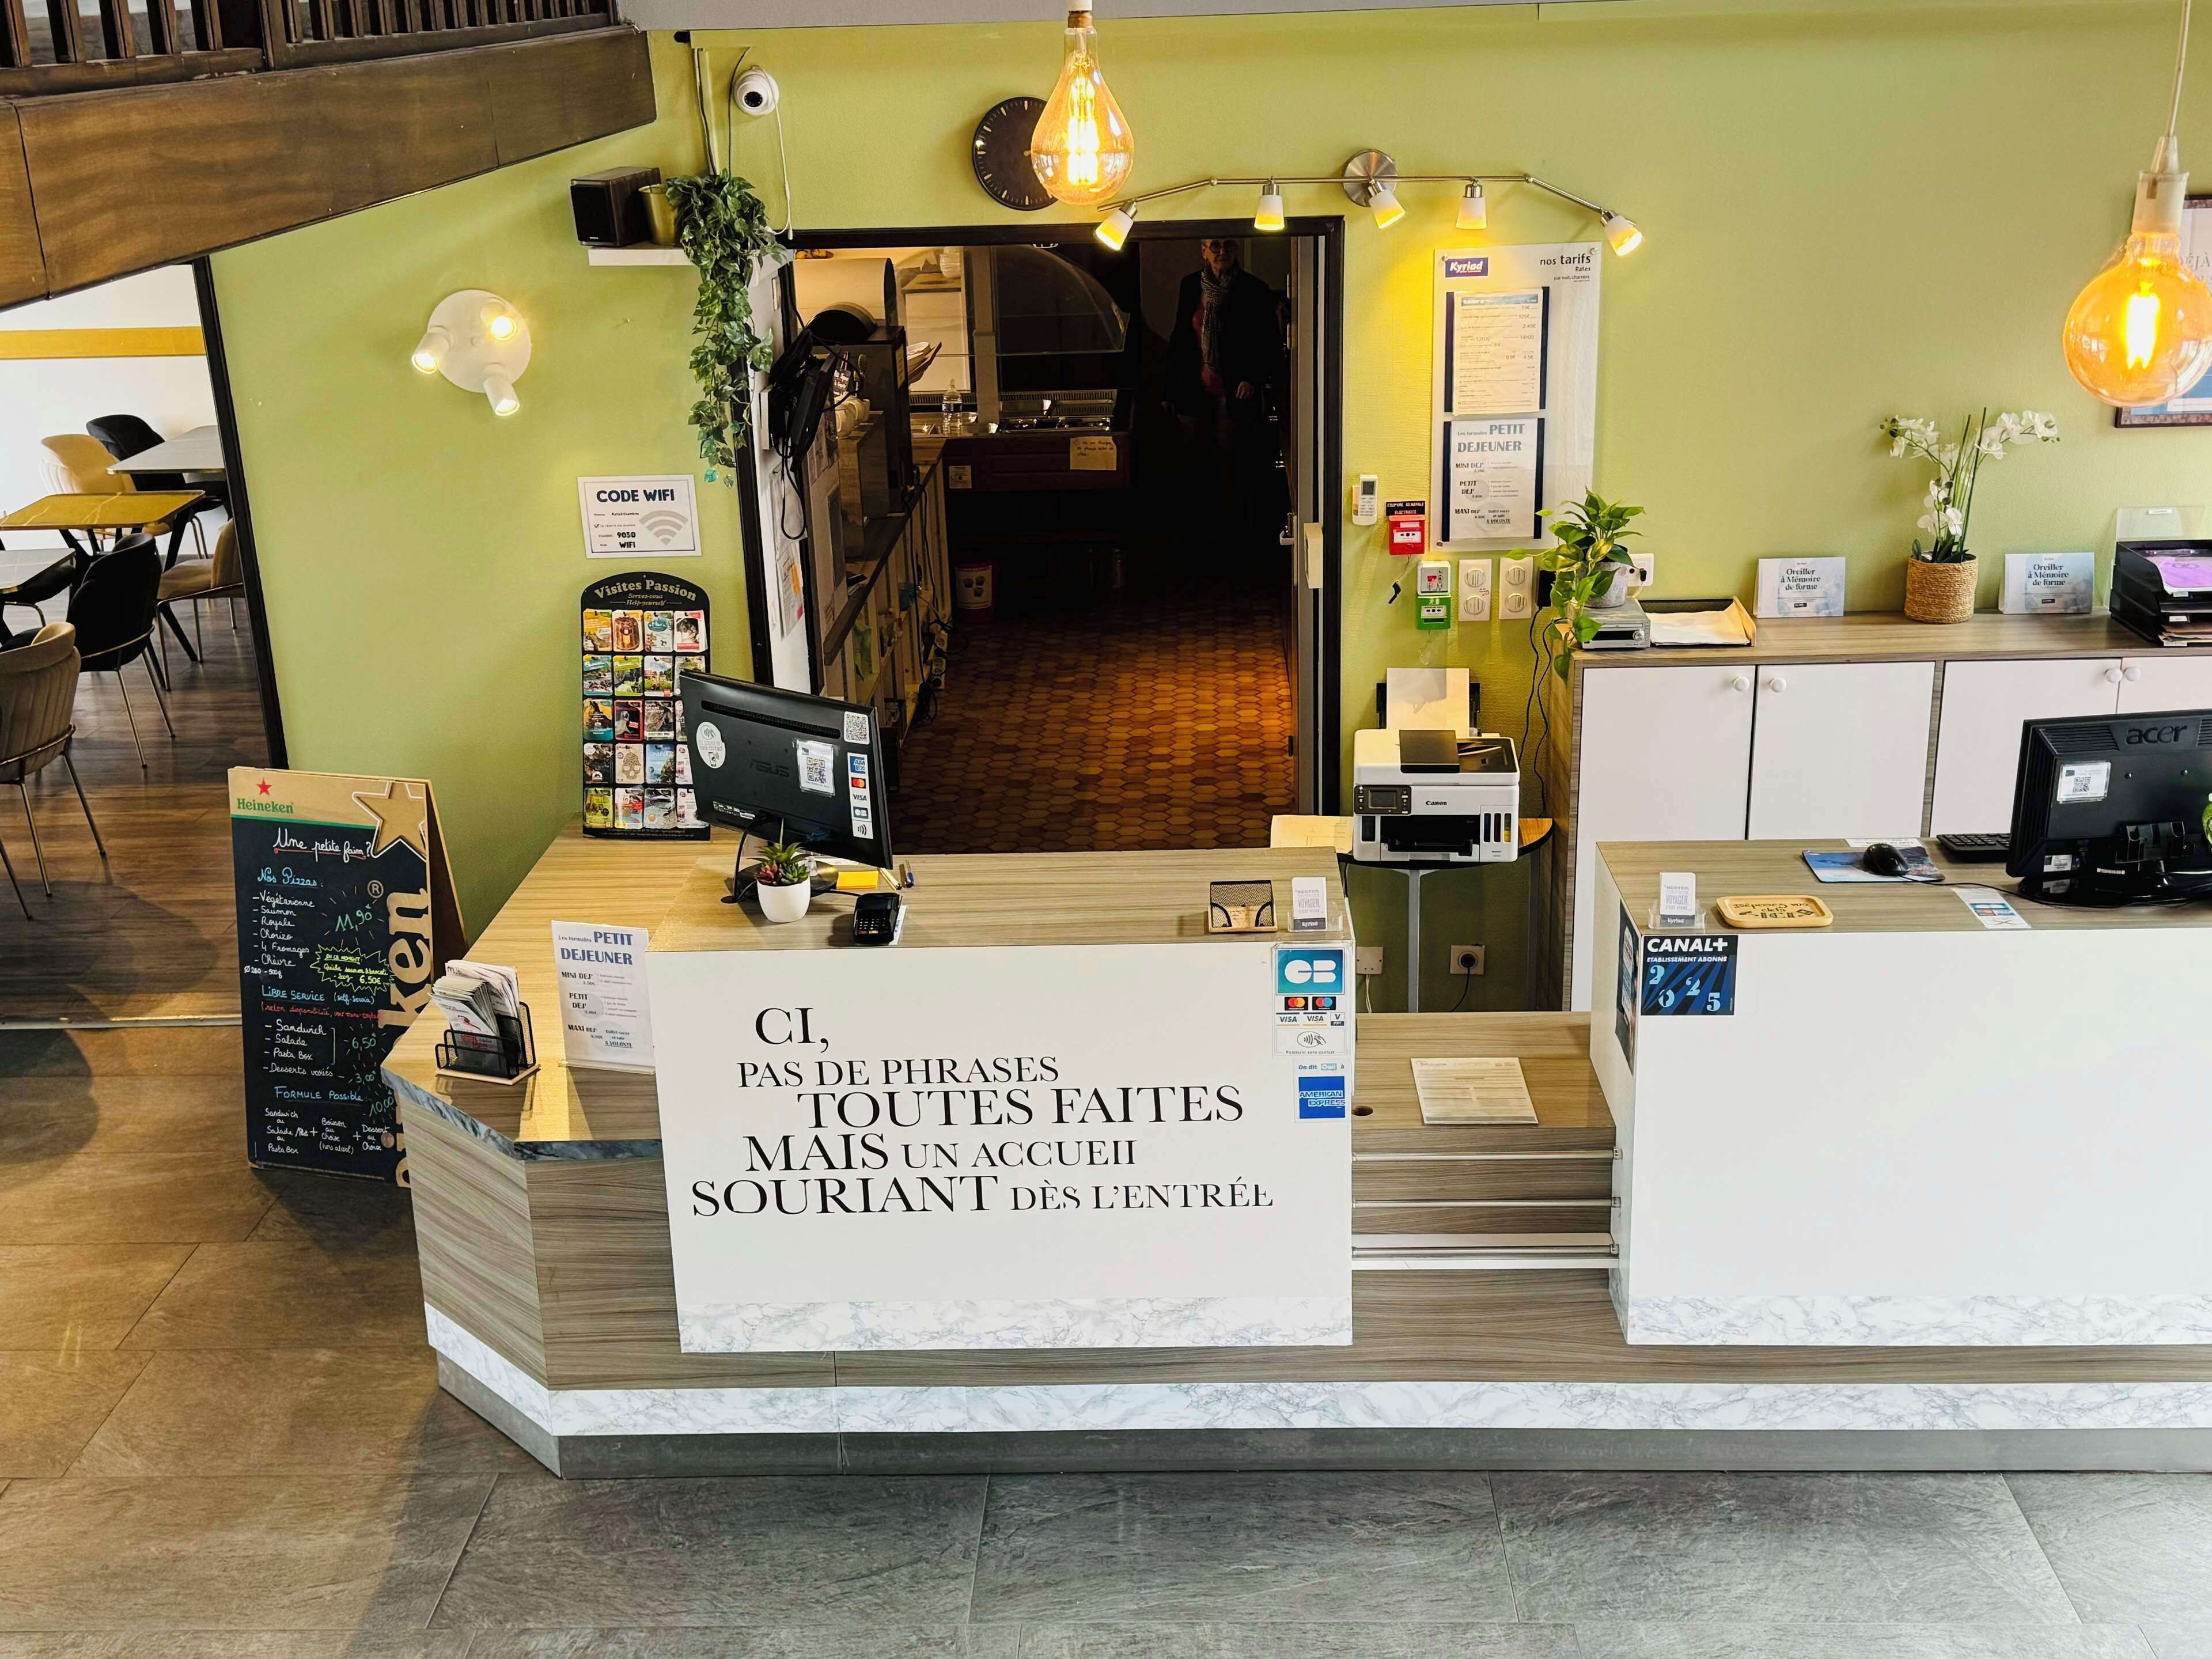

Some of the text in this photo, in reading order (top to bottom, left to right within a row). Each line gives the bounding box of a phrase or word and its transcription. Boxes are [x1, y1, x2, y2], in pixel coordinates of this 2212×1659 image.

[1560, 253, 1591, 264] tarifs
[1450, 260, 1483, 273] Kyriad
[1490, 424, 1525, 435] PETIT
[1457, 441, 1521, 452] DEJEUNER
[596, 489, 675, 502] CODE WIFI
[594, 579, 697, 601] Visites Passion
[2126, 724, 2188, 745] acer
[237, 798, 294, 814] Heineken
[273, 827, 307, 850] Une
[312, 839, 342, 862] petite
[257, 868, 277, 883] Nos
[259, 891, 315, 908] Végétarienne
[260, 906, 297, 917] Saumon
[261, 916, 295, 929] Royale
[260, 927, 293, 941] Chorizo
[593, 931, 634, 946] PETIT
[262, 941, 310, 959] 4 Fromages
[1647, 938, 1728, 953] CANAL+
[560, 948, 633, 965] DEJEUNER
[1284, 959, 1336, 984] CB
[276, 1018, 327, 1035] Sandwich
[755, 1007, 829, 1054] CI,
[275, 1035, 308, 1046] Salade
[274, 1047, 313, 1060] Pasta Box
[269, 1063, 307, 1075] Desserts
[737, 1056, 1059, 1088] PAS DE PHRASES
[274, 1086, 321, 1100] FORMULE
[265, 1108, 298, 1118] Sandwich
[797, 1085, 1243, 1128] TOUTES FAITES
[266, 1125, 293, 1136] Salade
[362, 1124, 391, 1134] Dessert
[268, 1143, 285, 1153] Pasta
[743, 1133, 888, 1172] MAIS
[901, 1143, 959, 1169] UN
[692, 1176, 998, 1217] SOURIANT
[1010, 1179, 1081, 1210] DÈS
